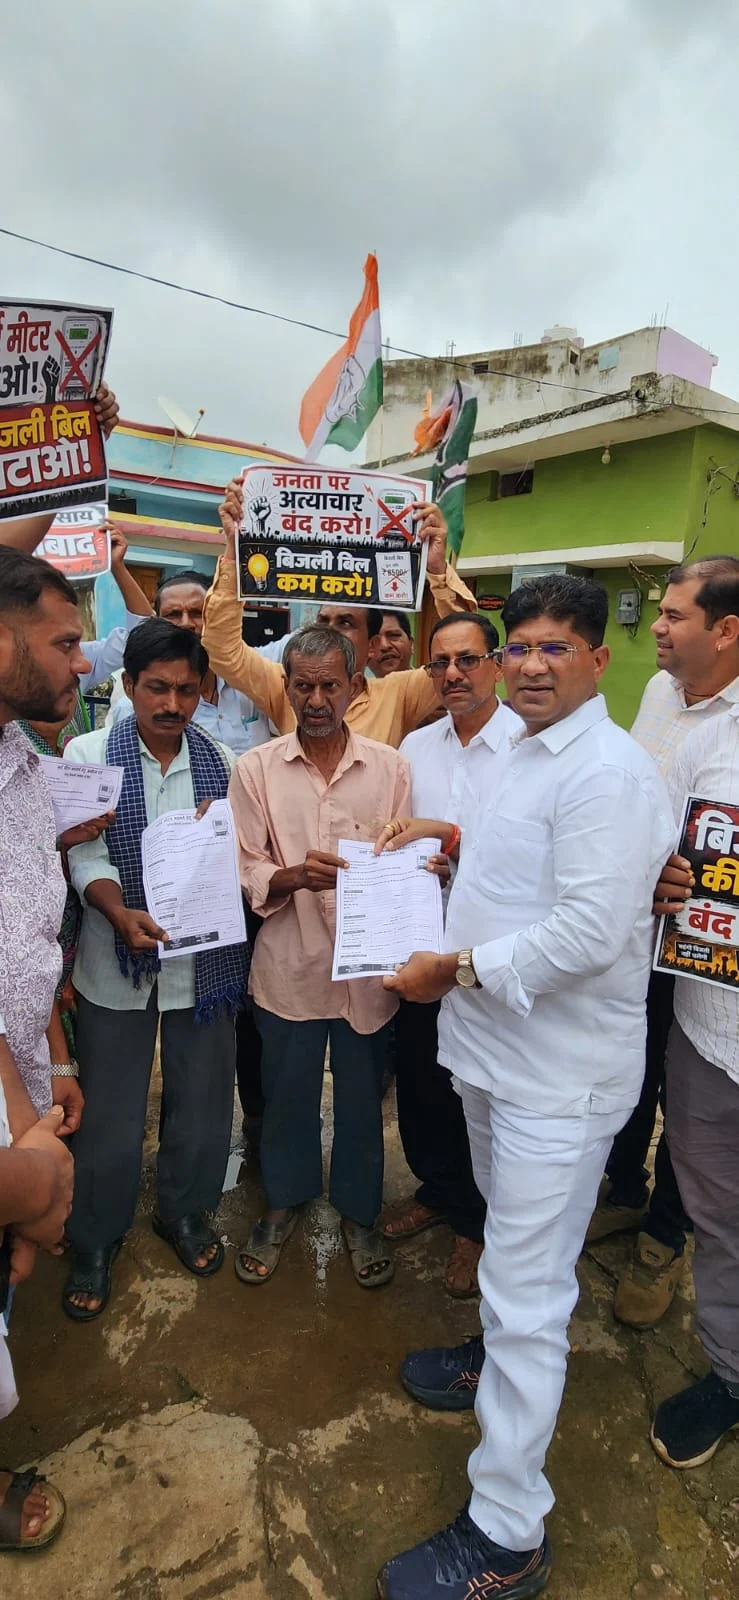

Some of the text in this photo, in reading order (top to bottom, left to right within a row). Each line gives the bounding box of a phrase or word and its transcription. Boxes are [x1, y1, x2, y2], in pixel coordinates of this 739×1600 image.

[7, 311, 51, 353] मीटर
[0, 355, 38, 398] ओ!
[0, 404, 91, 447] जली बिल
[272, 473, 351, 491] जनता पर
[279, 491, 364, 511] अत्याचार
[281, 510, 371, 535] बंद करो!
[36, 532, 97, 556] बाद
[275, 546, 371, 573] बिजली बिल
[276, 572, 373, 597] कम करो!
[695, 809, 739, 855] बि
[688, 902, 736, 940] बंद
